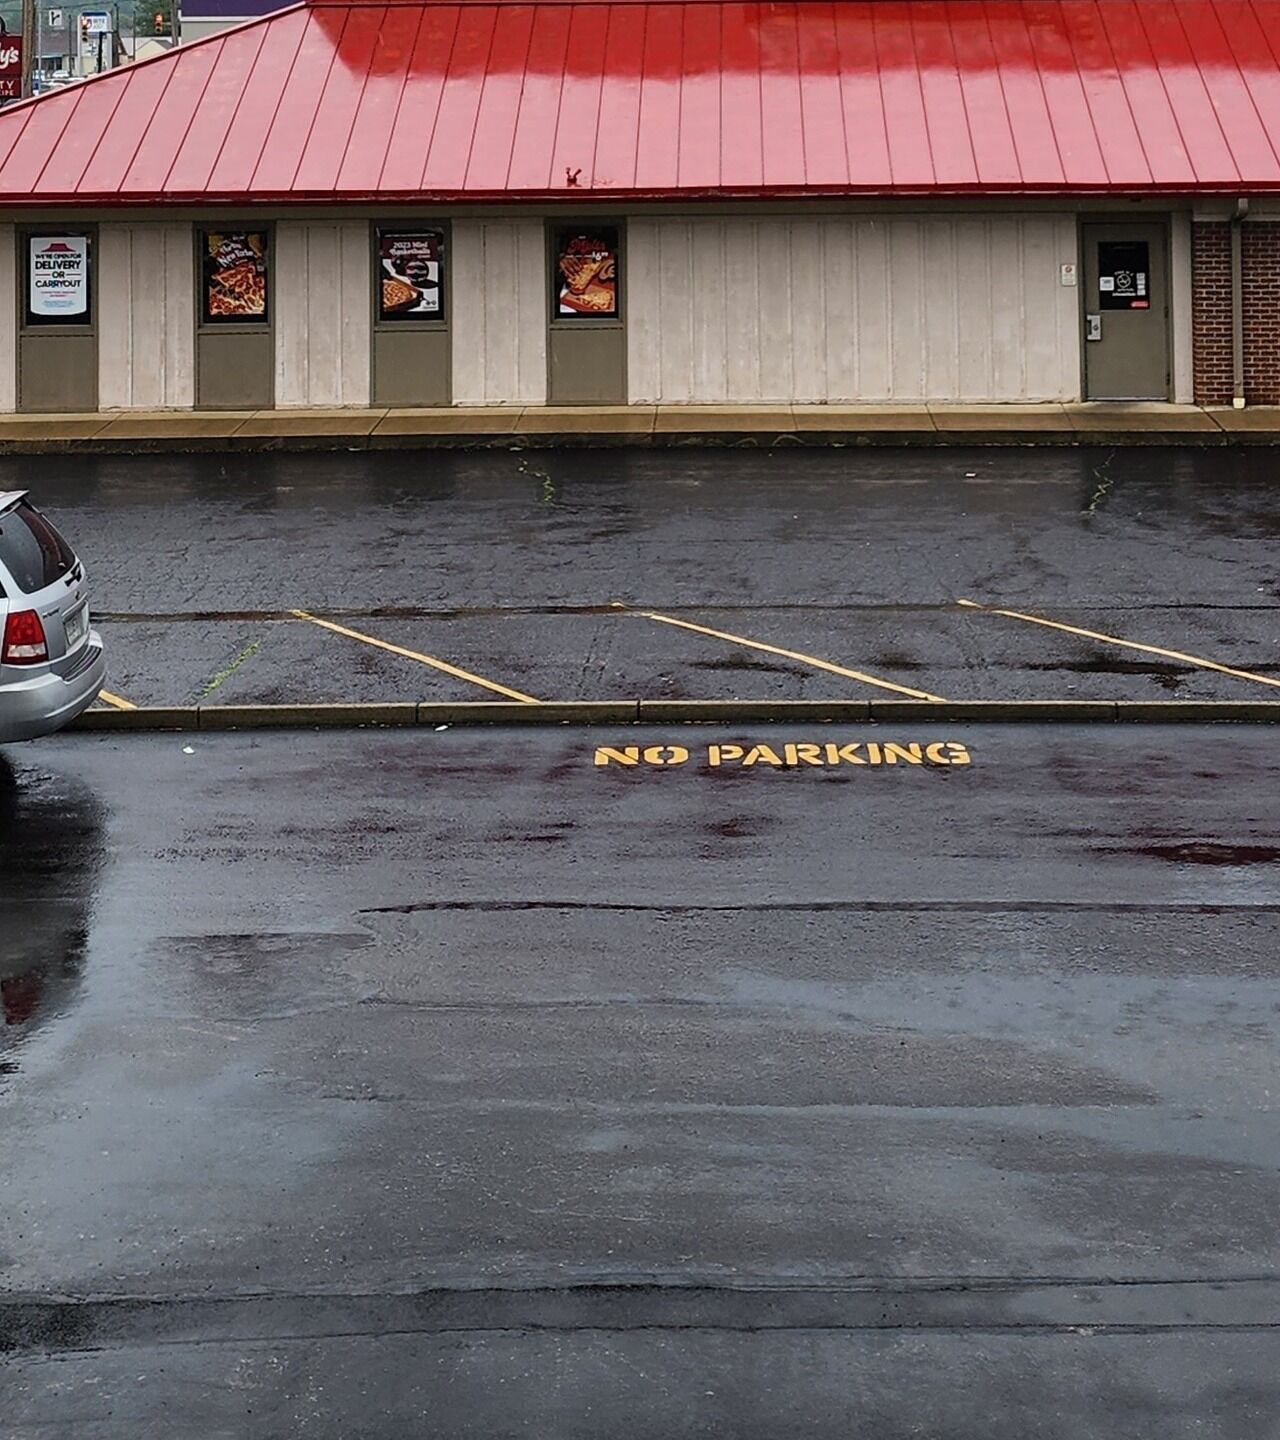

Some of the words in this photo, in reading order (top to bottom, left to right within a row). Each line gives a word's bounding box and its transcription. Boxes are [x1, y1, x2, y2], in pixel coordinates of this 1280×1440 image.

[35, 260, 81, 270] DELIVERY
[35, 280, 81, 288] CARRYOUT
[595, 746, 689, 766] NO
[709, 742, 971, 766] PARKING
